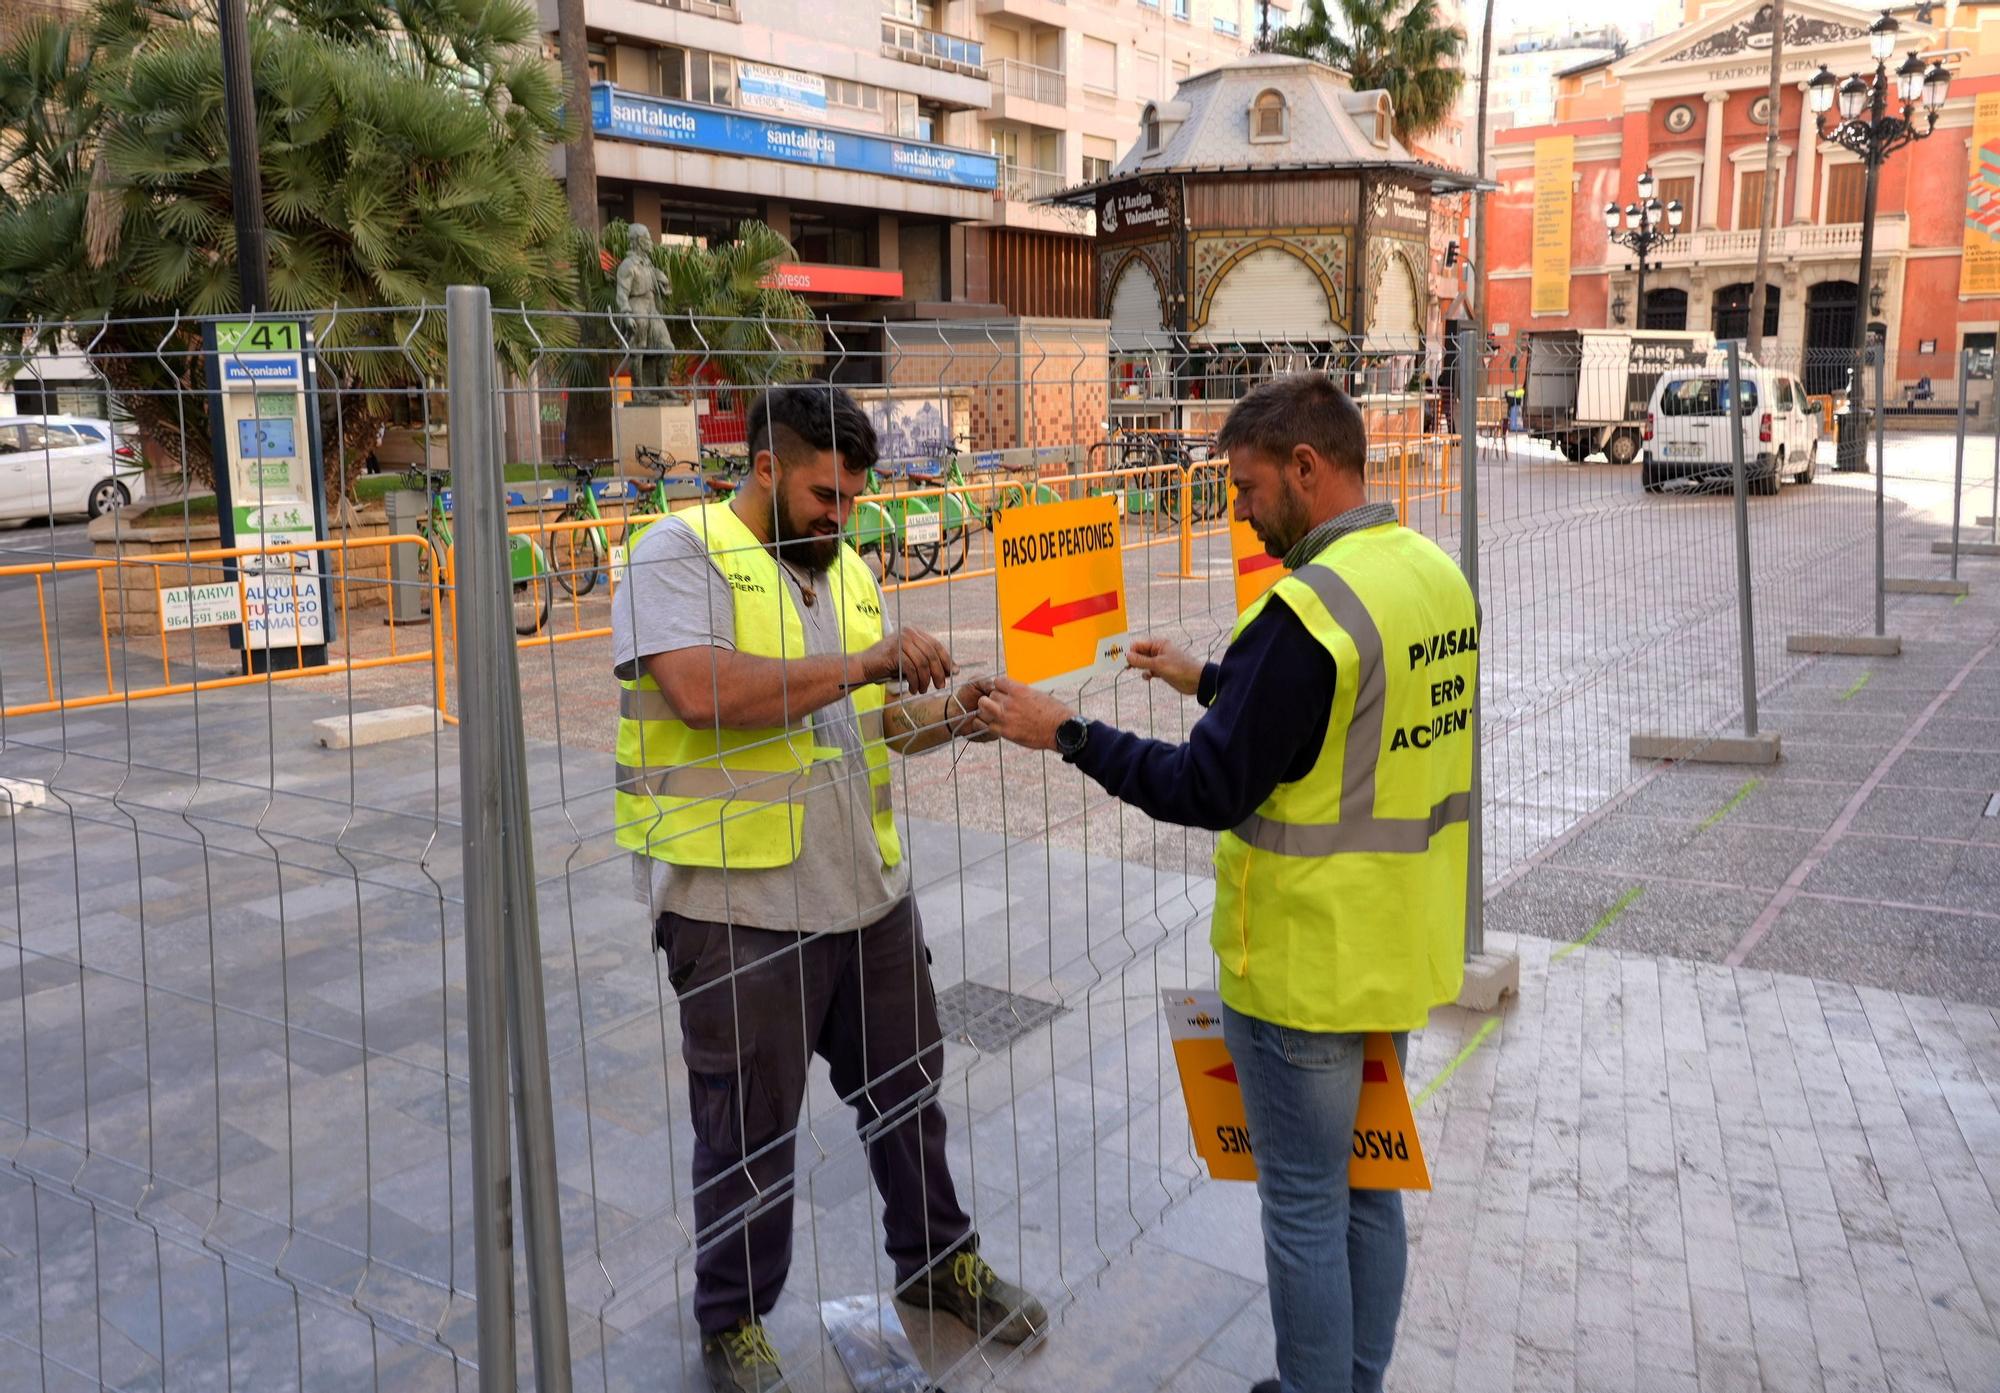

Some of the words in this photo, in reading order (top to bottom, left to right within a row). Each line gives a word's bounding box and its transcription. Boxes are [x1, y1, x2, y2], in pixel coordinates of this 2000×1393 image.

[1709, 66, 1753, 81] TEATRO
[1755, 60, 1820, 76] PRCIPAL
[613, 103, 697, 133] santalucía
[767, 129, 835, 153] santalucía
[1118, 192, 1152, 210] L'Antiga
[1125, 206, 1170, 225] Valenciana
[251, 325, 292, 350] 41
[1630, 343, 1685, 364] 'Antiga
[1002, 534, 1037, 568] PASO
[1039, 531, 1057, 561] DE
[1058, 521, 1114, 557] PEATONES
[246, 584, 316, 601] ALQUILA
[167, 615, 189, 627] 964
[193, 613, 212, 624] 591
[215, 610, 237, 621] 588
[1352, 1129, 1409, 1161] PASO
